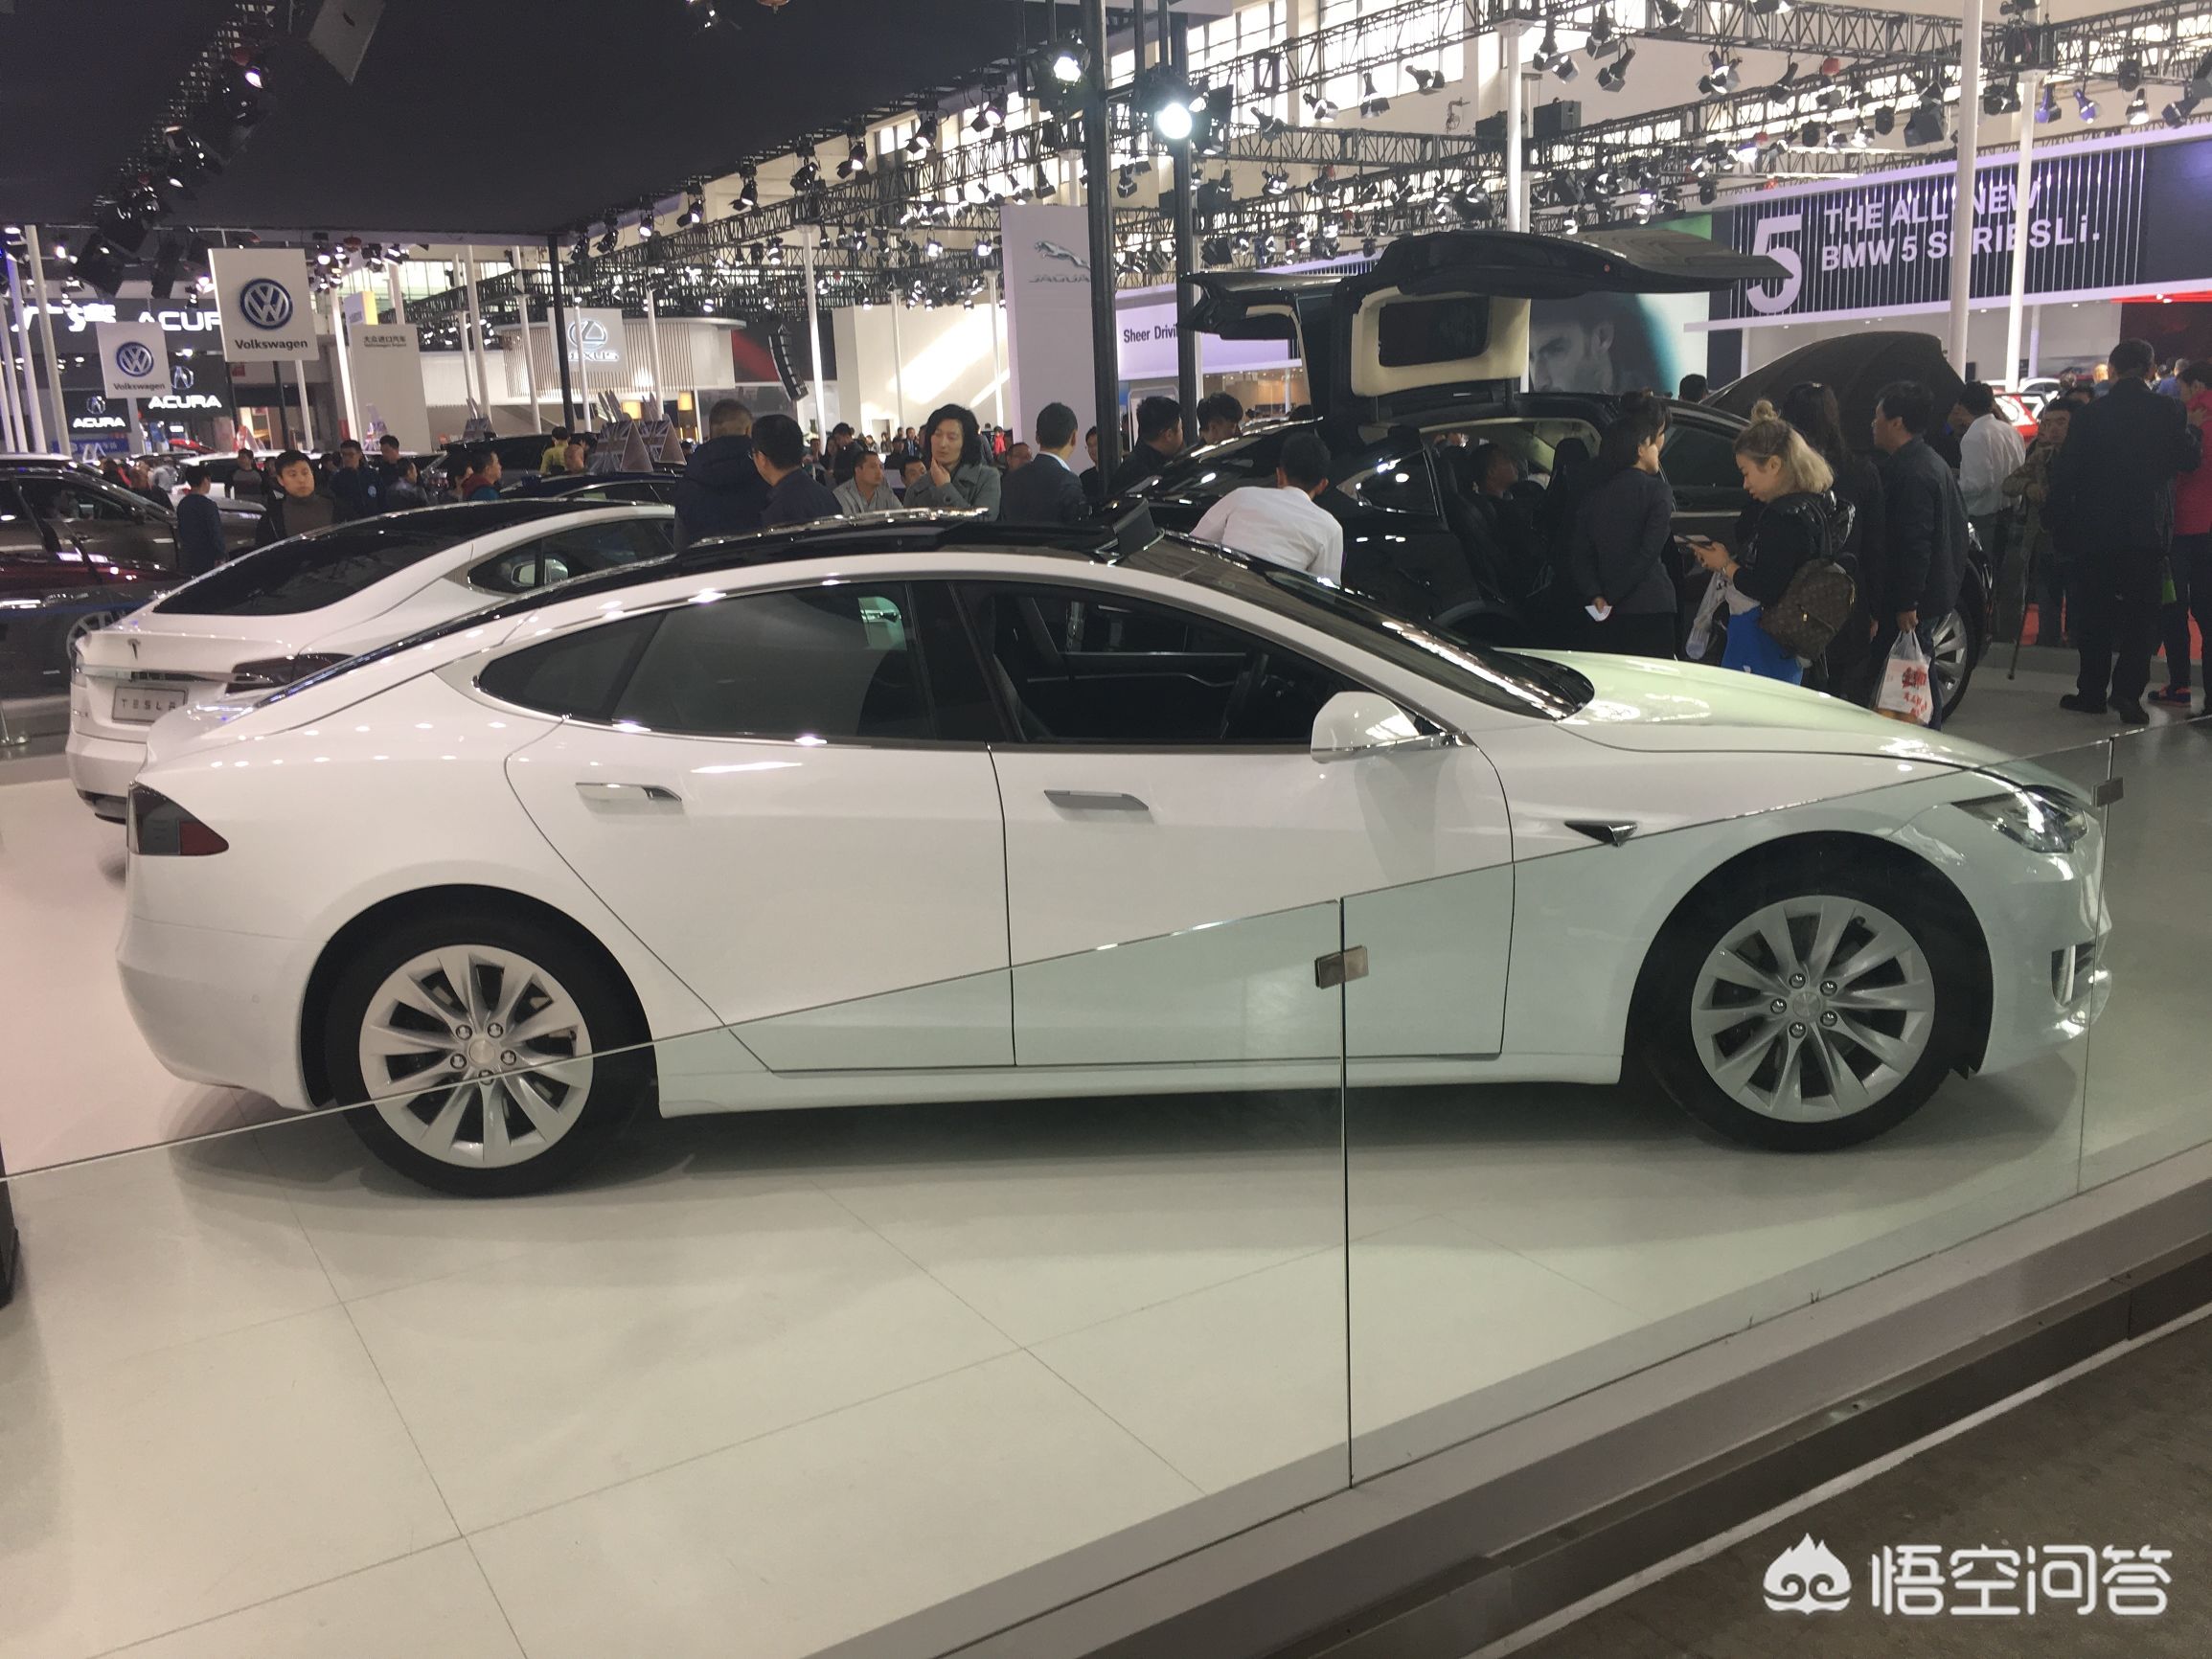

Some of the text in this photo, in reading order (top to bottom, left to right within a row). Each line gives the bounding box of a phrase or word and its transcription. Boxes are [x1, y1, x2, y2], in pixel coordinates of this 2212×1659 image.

[1823, 202, 1883, 234] THE
[1821, 238, 1895, 271] BMW
[1902, 236, 1918, 261] 5
[1746, 214, 1802, 314] 5
[1028, 274, 1091, 283] JAGUA
[1123, 324, 1177, 343] Sheer Drivi
[235, 339, 308, 351] Volkswagen
[148, 395, 222, 409] ACURA
[73, 417, 125, 428] ACURA
